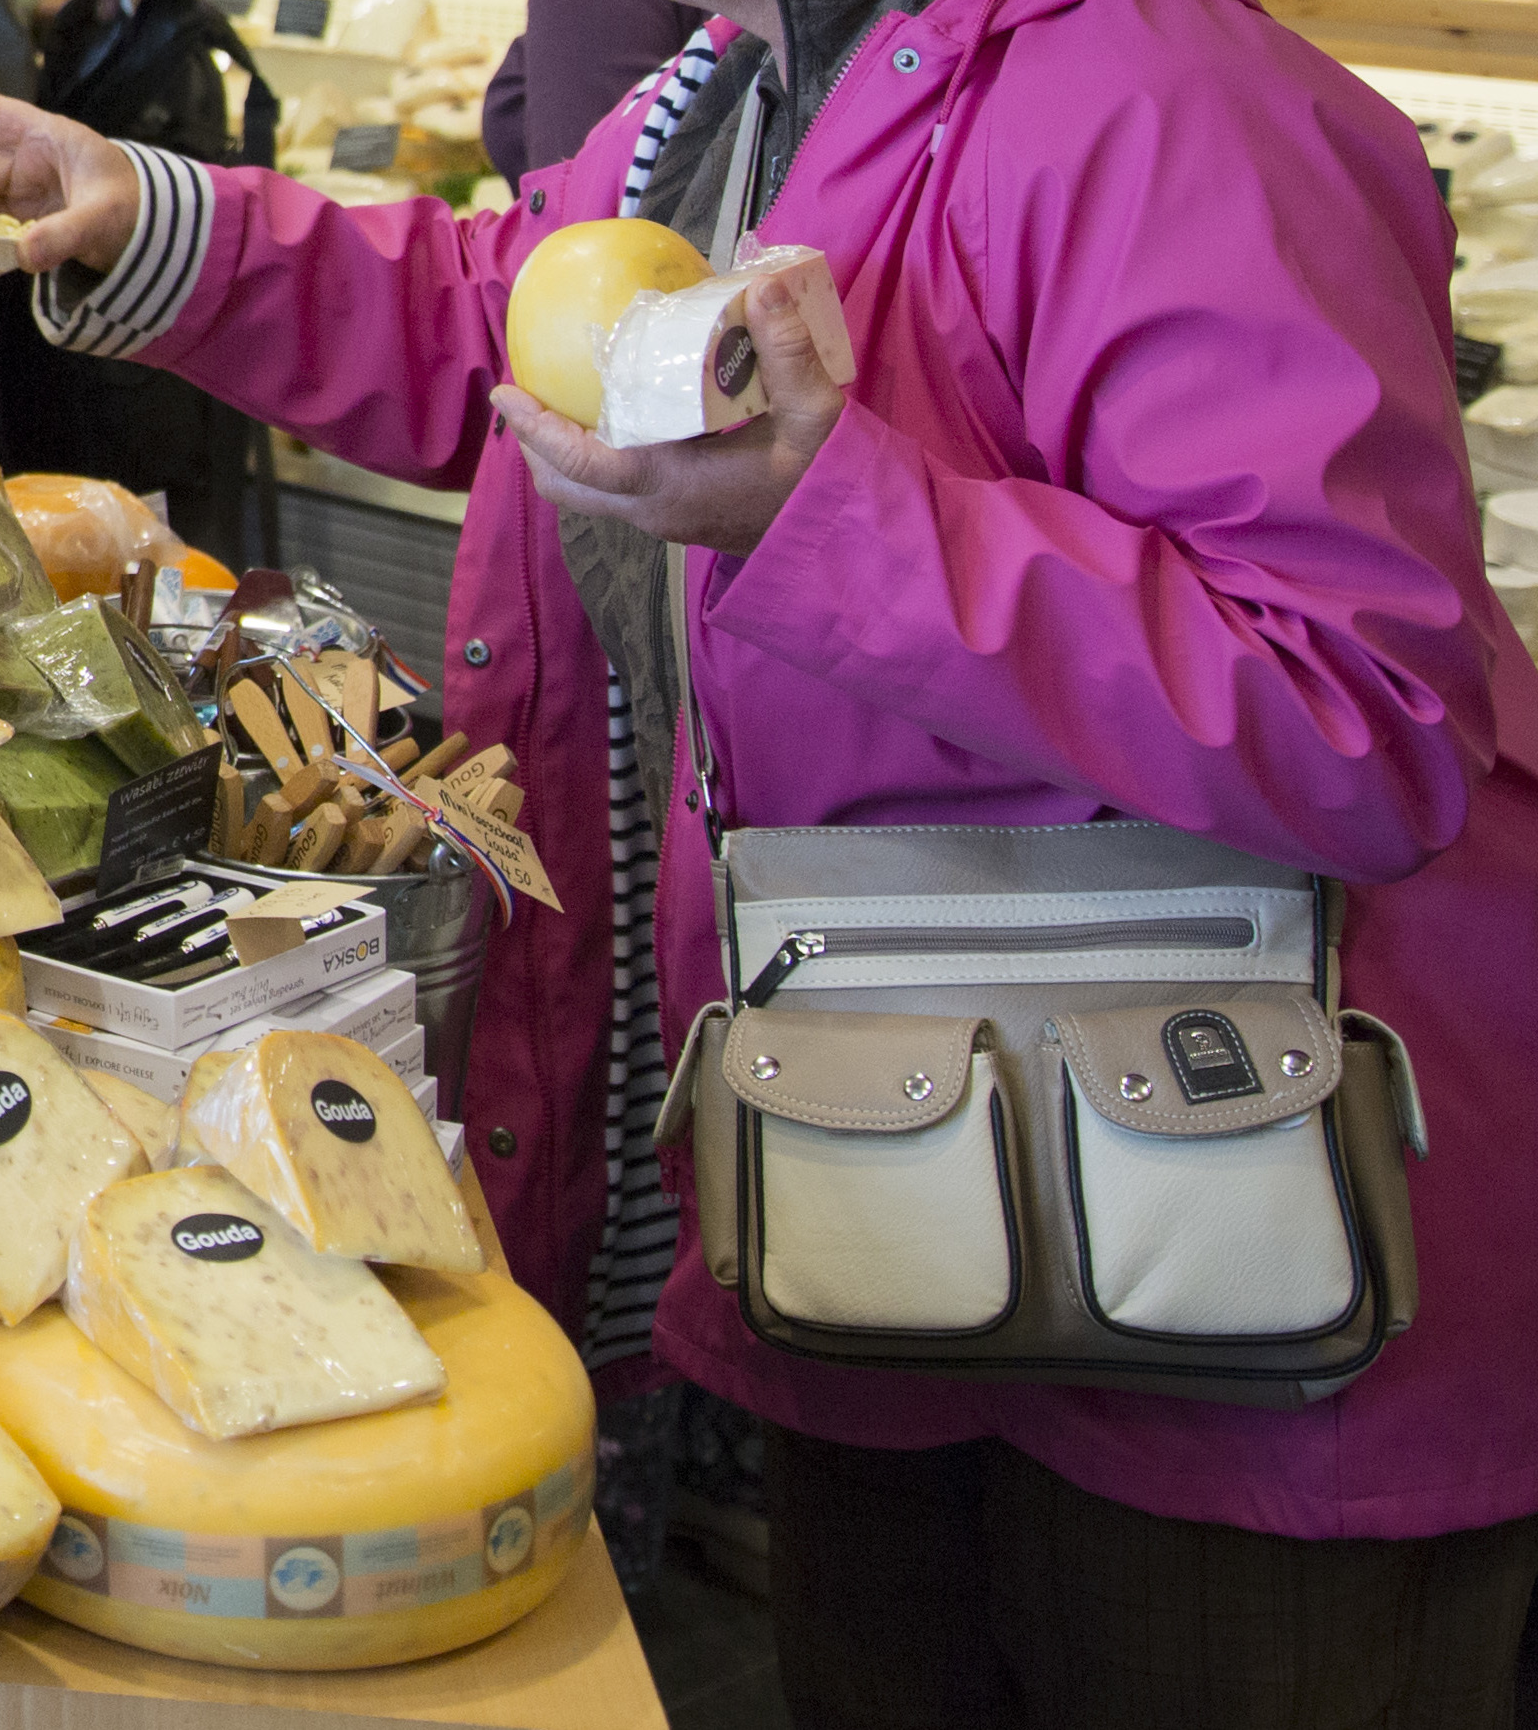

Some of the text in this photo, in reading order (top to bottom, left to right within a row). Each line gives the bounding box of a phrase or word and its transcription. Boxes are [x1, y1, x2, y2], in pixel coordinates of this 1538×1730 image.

[716, 335, 753, 388] Gouda
[120, 773, 165, 806] Wasabi
[166, 756, 210, 782] zeewier
[451, 762, 486, 791] Gou
[292, 827, 318, 870] Goud
[322, 936, 380, 974] BOSKA
[85, 1056, 154, 1080] EXPLORE CHEESE
[315, 1100, 373, 1122] Gouda
[176, 1225, 259, 1250] Gouda
[157, 1578, 212, 1606] Noix
